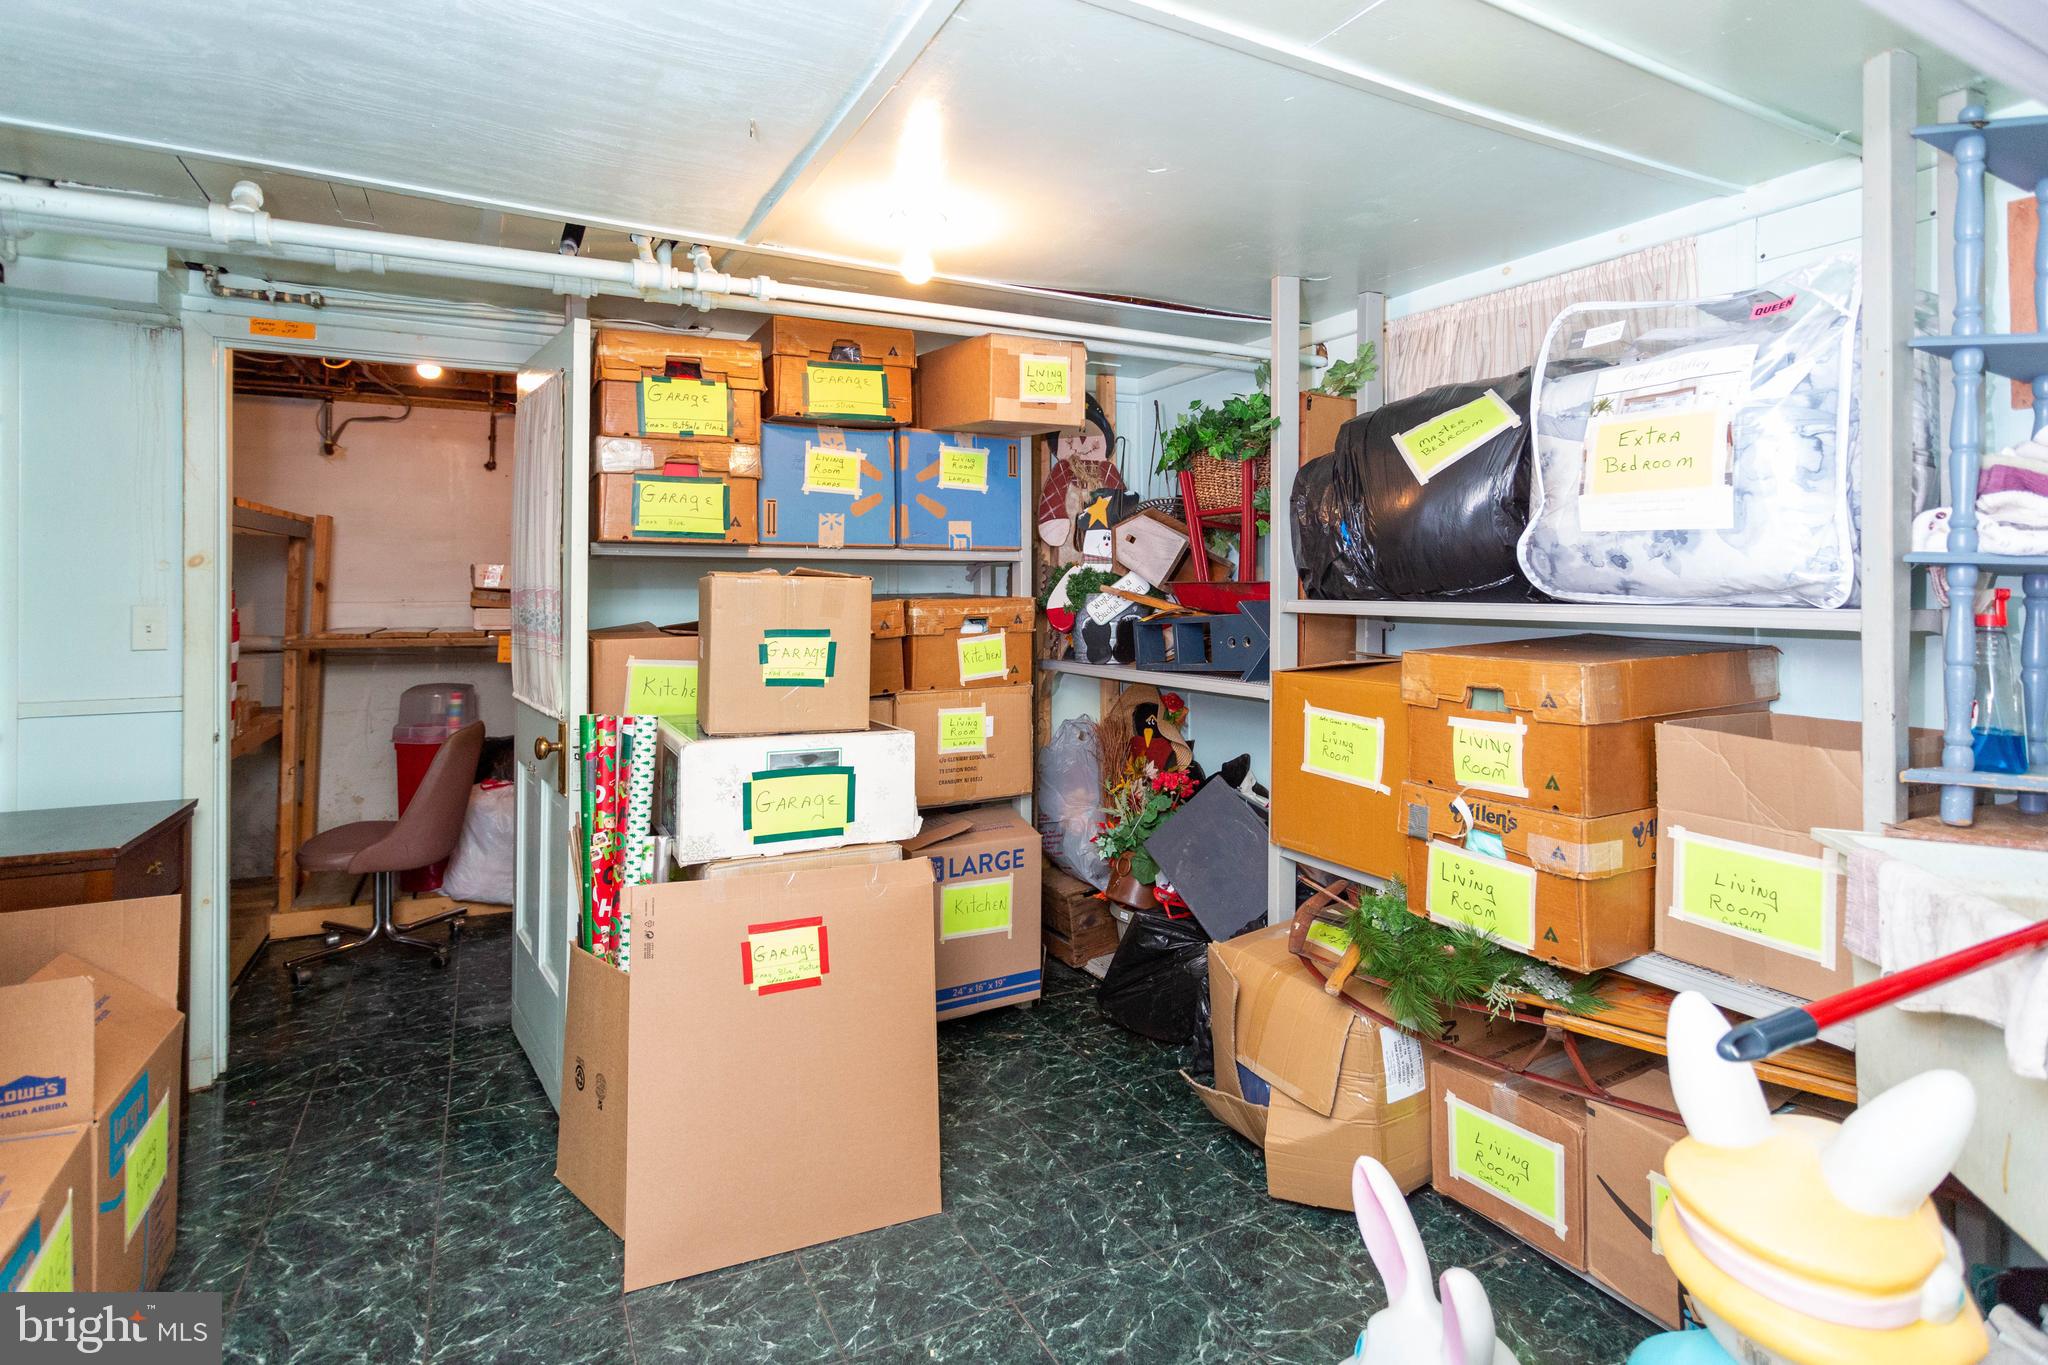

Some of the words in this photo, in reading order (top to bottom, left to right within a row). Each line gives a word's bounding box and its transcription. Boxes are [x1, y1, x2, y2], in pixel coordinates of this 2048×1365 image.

[1754, 297, 1795, 316] QUEEN
[642, 676, 698, 698] Kitche
[948, 848, 1025, 879] LARGE
[0, 1081, 59, 1103] OWE'S
[32, 1101, 68, 1113] ARRIBA
